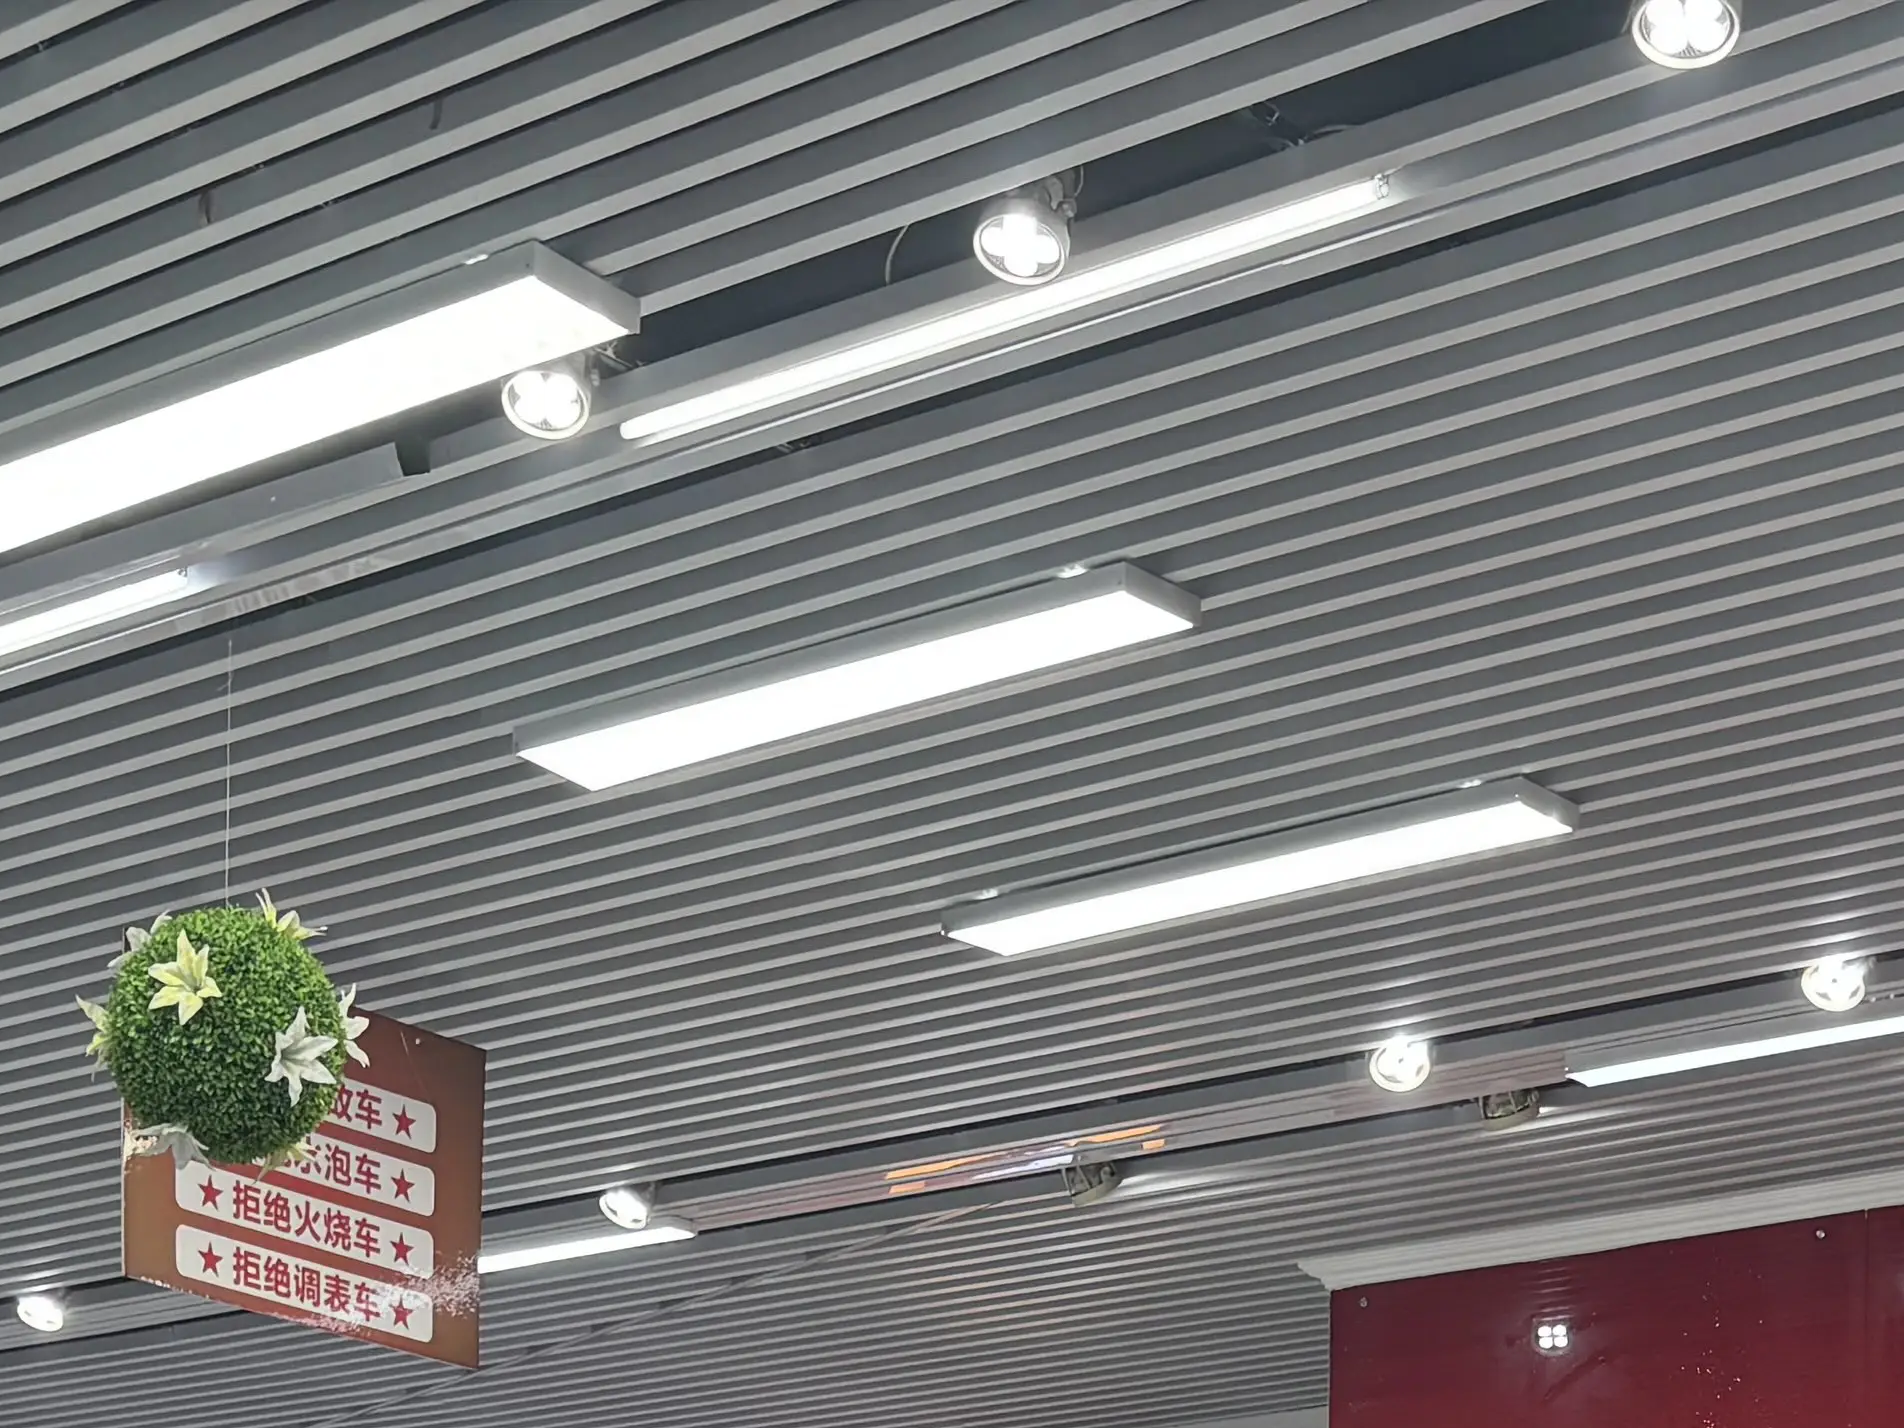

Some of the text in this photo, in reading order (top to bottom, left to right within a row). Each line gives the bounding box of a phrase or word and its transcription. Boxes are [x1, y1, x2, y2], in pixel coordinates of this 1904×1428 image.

[232, 1180, 382, 1259] 拒绝火烧车
[232, 1246, 382, 1322] 拒绝调表车
